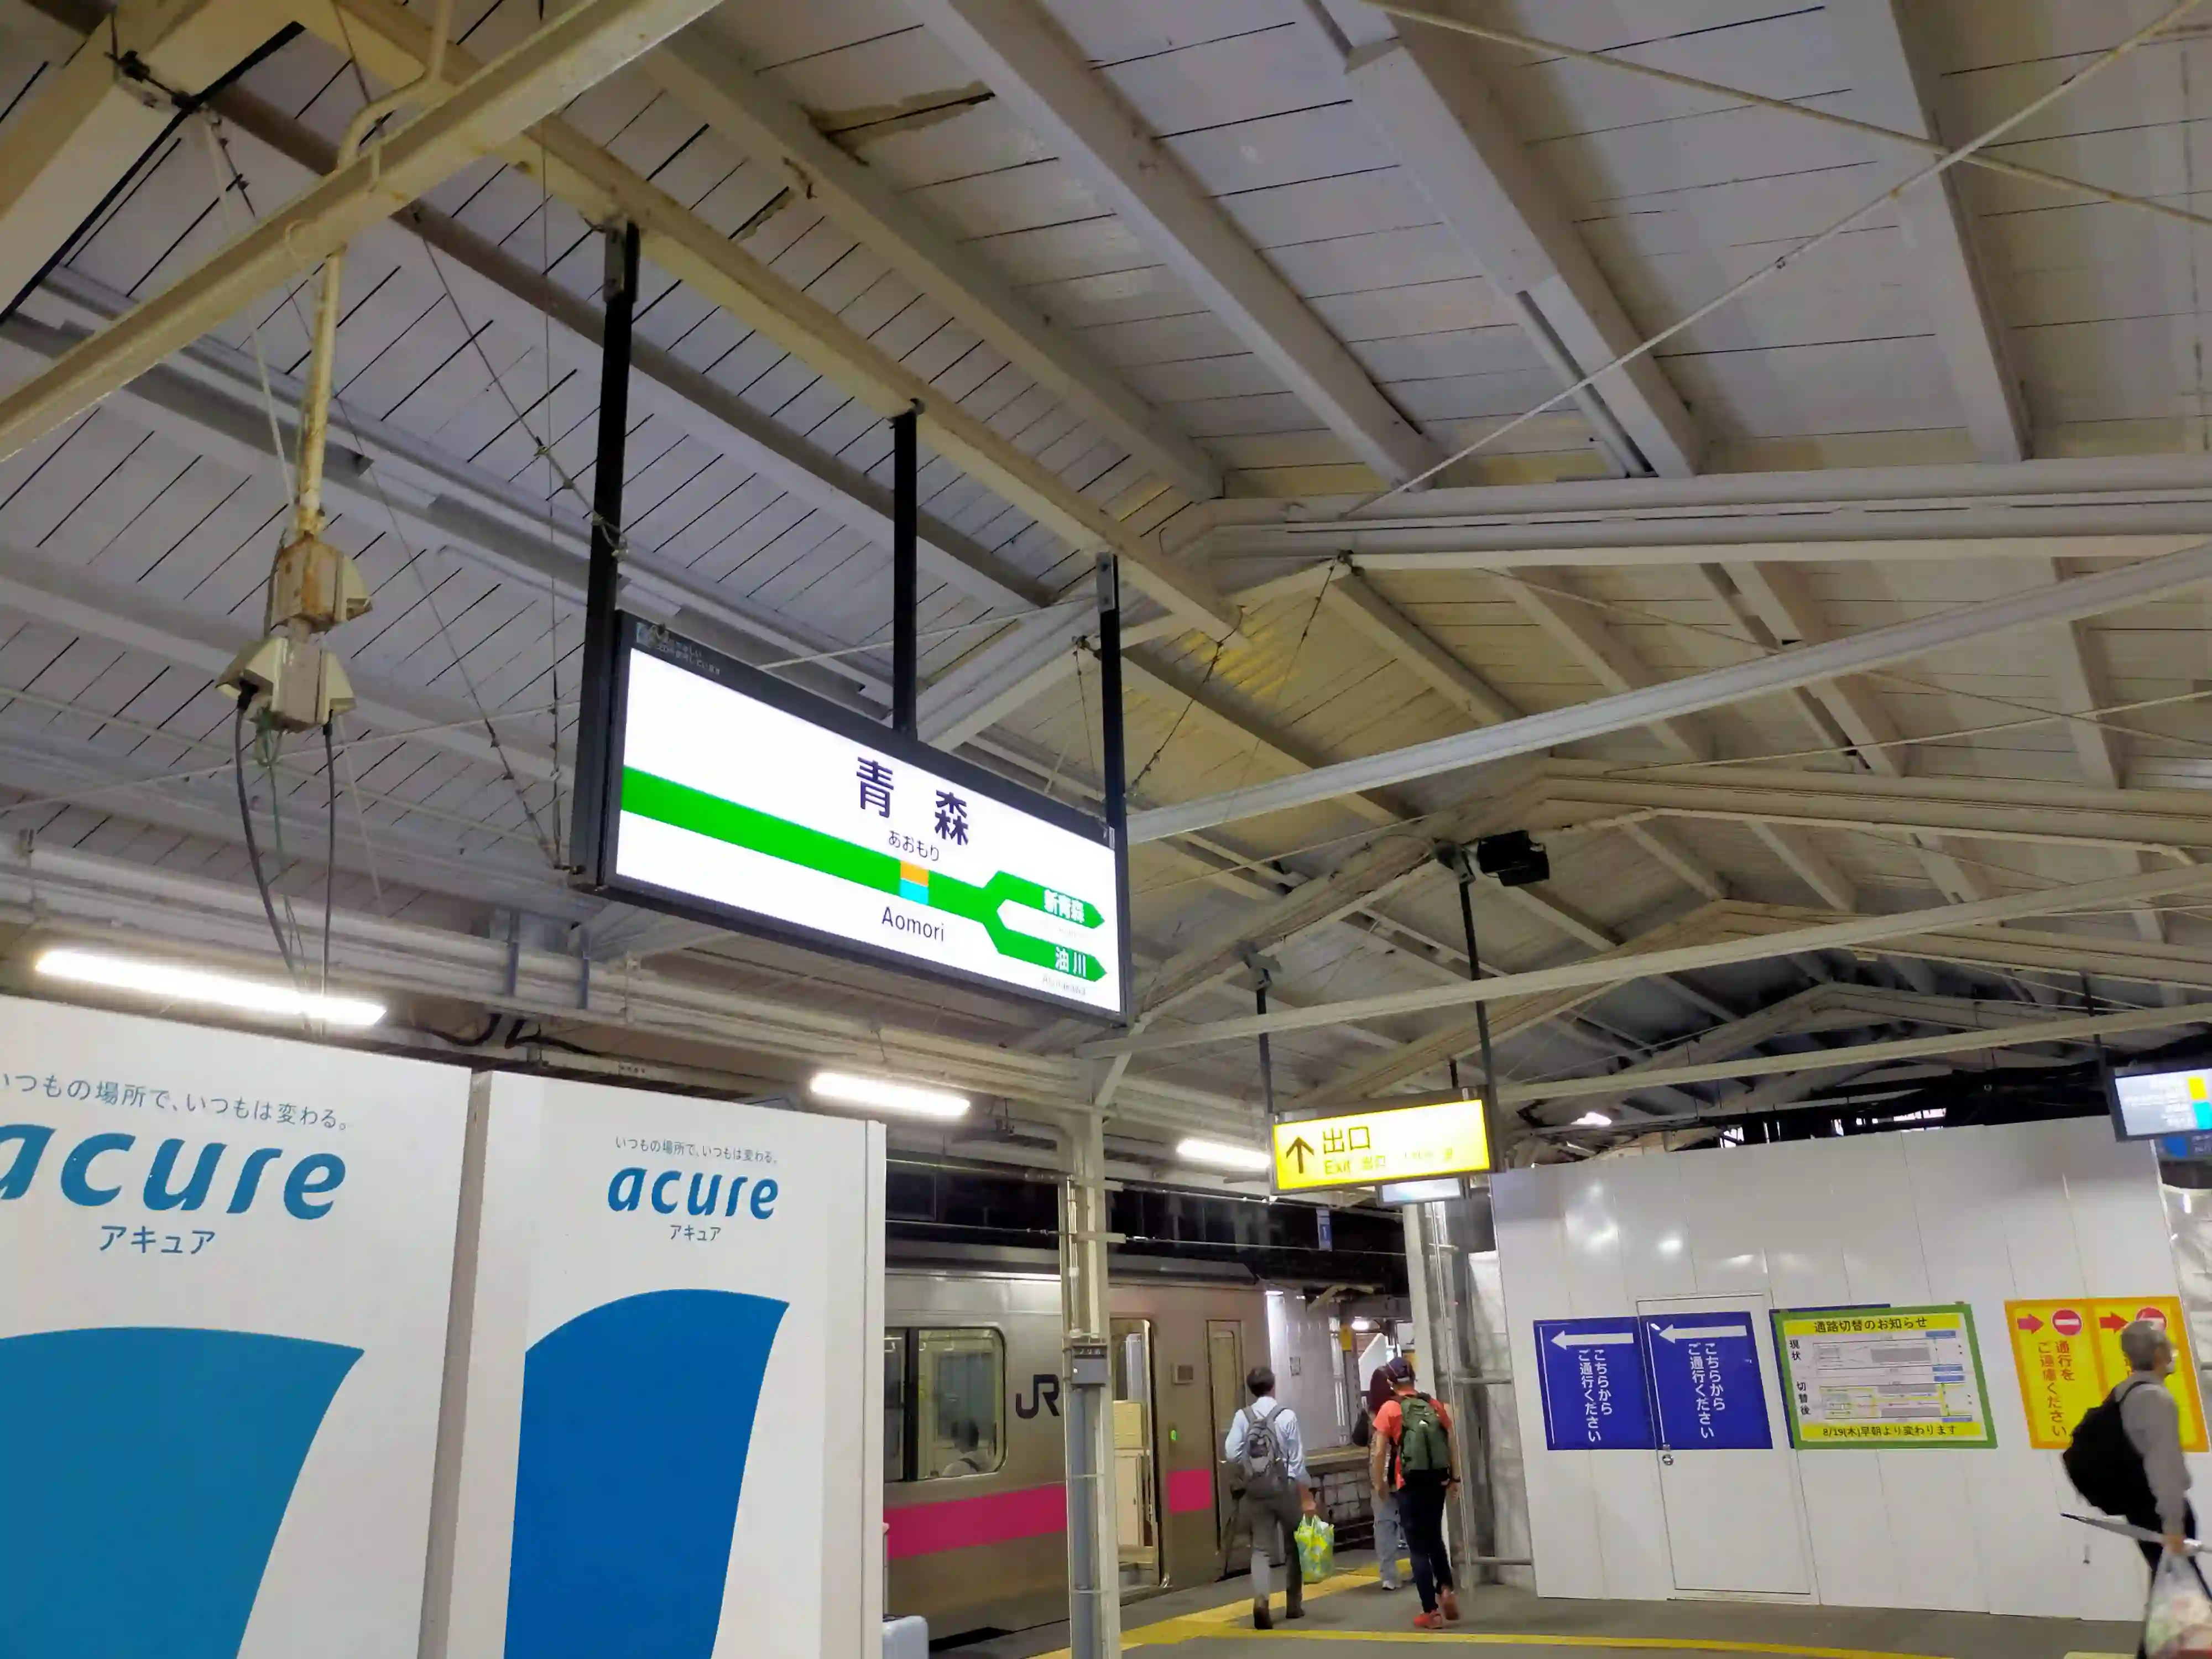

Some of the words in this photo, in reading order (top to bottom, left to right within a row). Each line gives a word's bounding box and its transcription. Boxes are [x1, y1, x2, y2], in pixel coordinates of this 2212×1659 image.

[856, 756, 969, 846] 青森
[889, 830, 940, 861] あおもり
[881, 906, 945, 942] Aomori
[1055, 946, 1087, 978] 油川
[615, 1136, 778, 1164] いつもの場所で、いつもは変わる。
[1323, 1126, 1370, 1155] 出口
[0, 1124, 346, 1220] acure
[1324, 1159, 1351, 1175] Exit
[608, 1166, 779, 1220] acure
[100, 1225, 216, 1254] アキュア
[670, 1224, 722, 1241] アキュア
[1814, 1317, 1928, 1333] 通路切替のお知らせ
[1705, 1342, 1725, 1411] こちらから
[2054, 1340, 2075, 1381] 通行を
[1015, 1374, 1060, 1419] JR
[1578, 1349, 1601, 1442] ご通行ください
[1594, 1349, 1613, 1415] こちらから
[1688, 1342, 1715, 1439] ご通行ください
